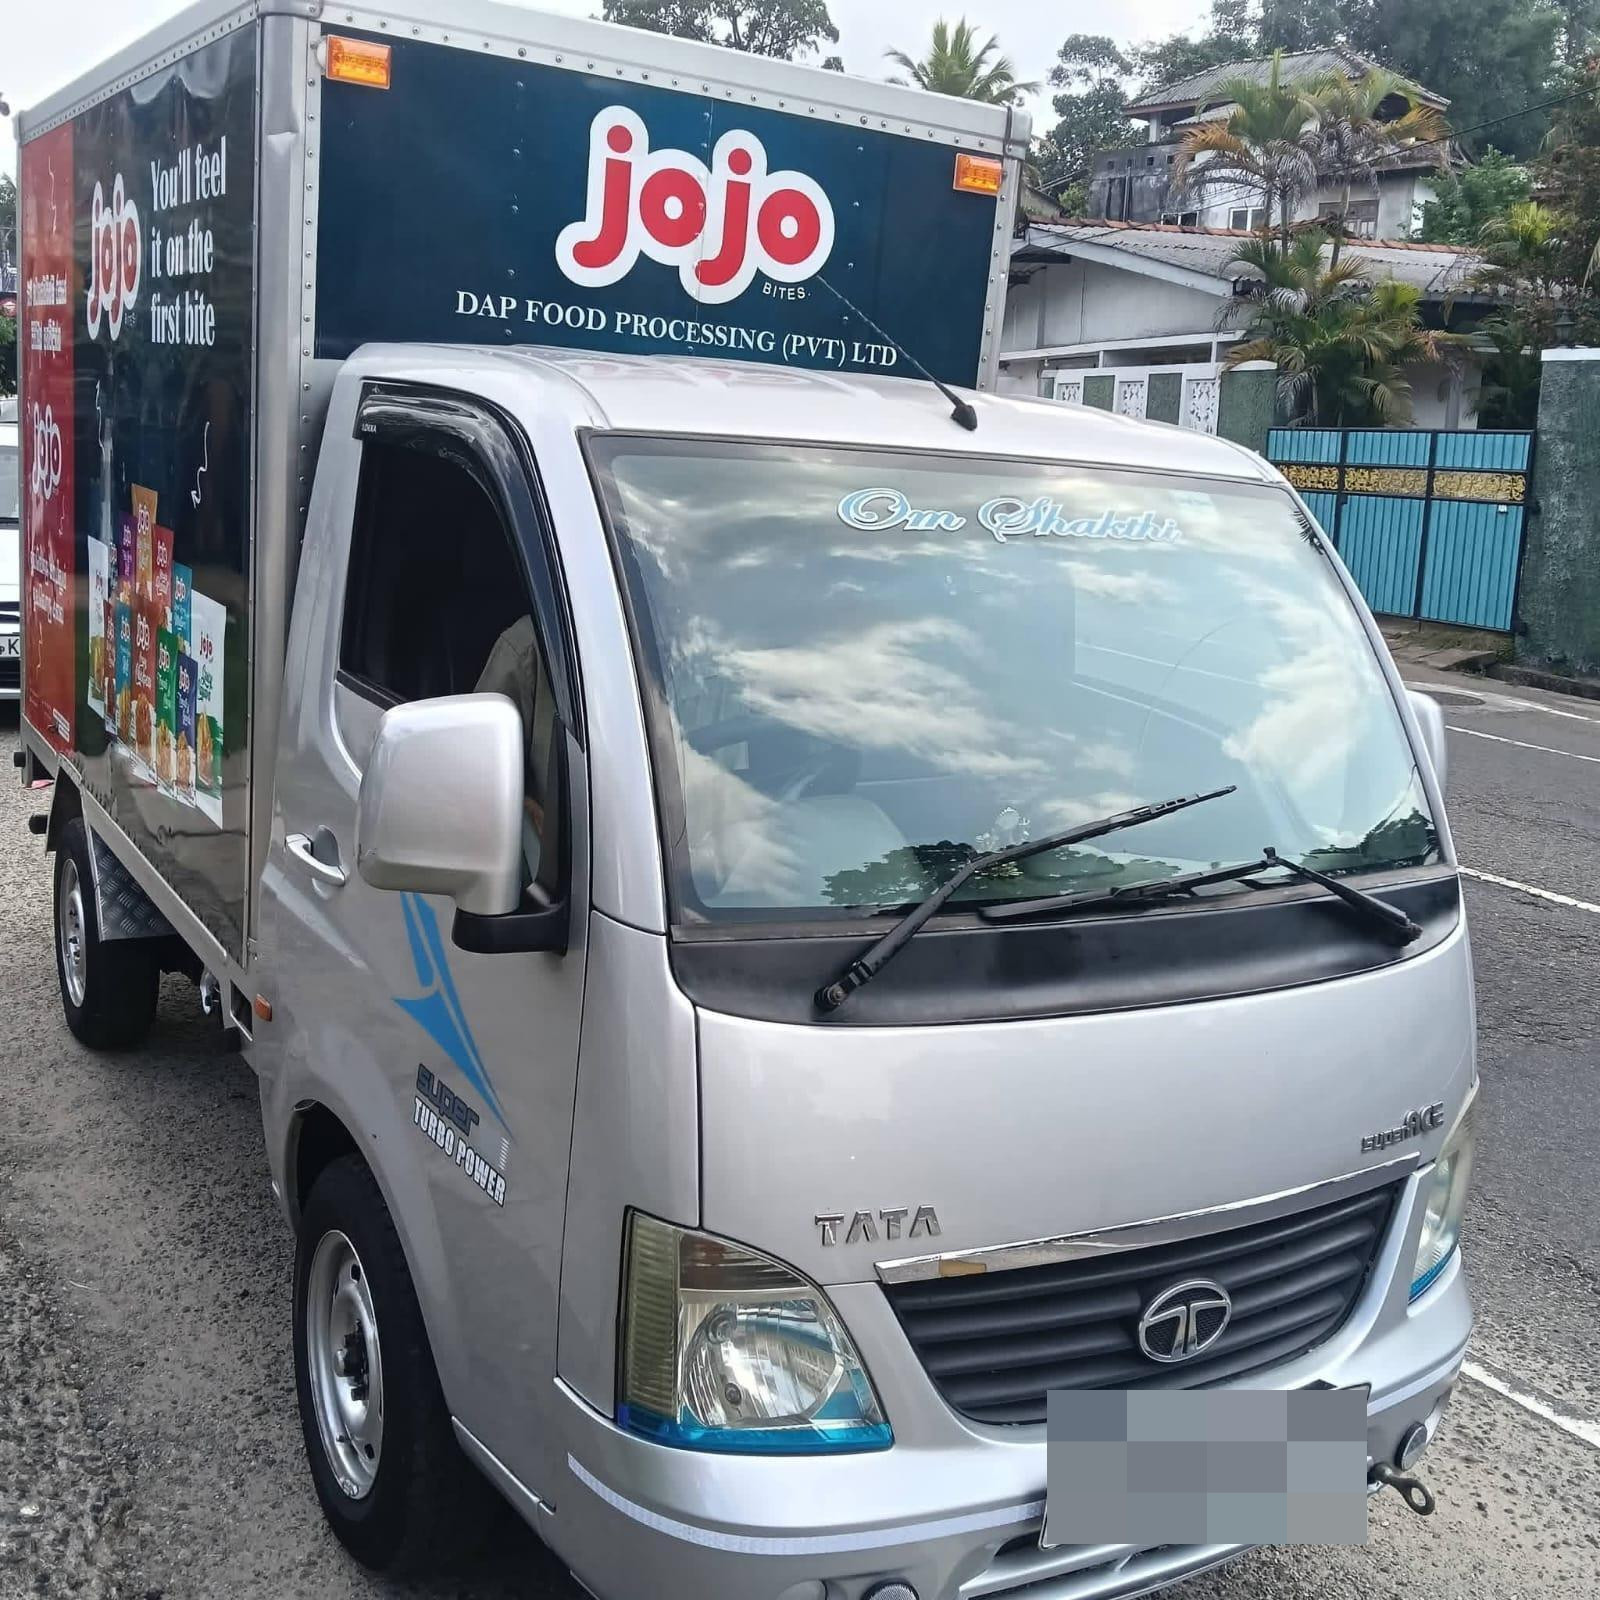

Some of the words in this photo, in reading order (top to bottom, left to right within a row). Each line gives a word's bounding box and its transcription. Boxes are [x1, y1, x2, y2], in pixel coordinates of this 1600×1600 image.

[151, 149, 191, 211] You'll
[195, 136, 227, 201] feel
[555, 105, 835, 304] jojo
[87, 172, 141, 341] jojo
[151, 226, 162, 278] it
[166, 235, 184, 277] on
[187, 218, 214, 275] the
[151, 291, 181, 345] first
[185, 289, 216, 346] bite
[762, 281, 806, 301] BITES
[455, 290, 517, 319] DAP
[524, 299, 607, 332] FOOD
[614, 311, 776, 353] PROCESSING
[781, 332, 847, 367] (PVT)
[850, 341, 898, 368] LTD
[32, 401, 62, 500] jojo
[837, 487, 967, 531] Om
[199, 630, 213, 660] jojo
[413, 1096, 456, 1157] TURBO
[455, 1137, 507, 1209] POWER
[815, 1205, 942, 1247] TATA
